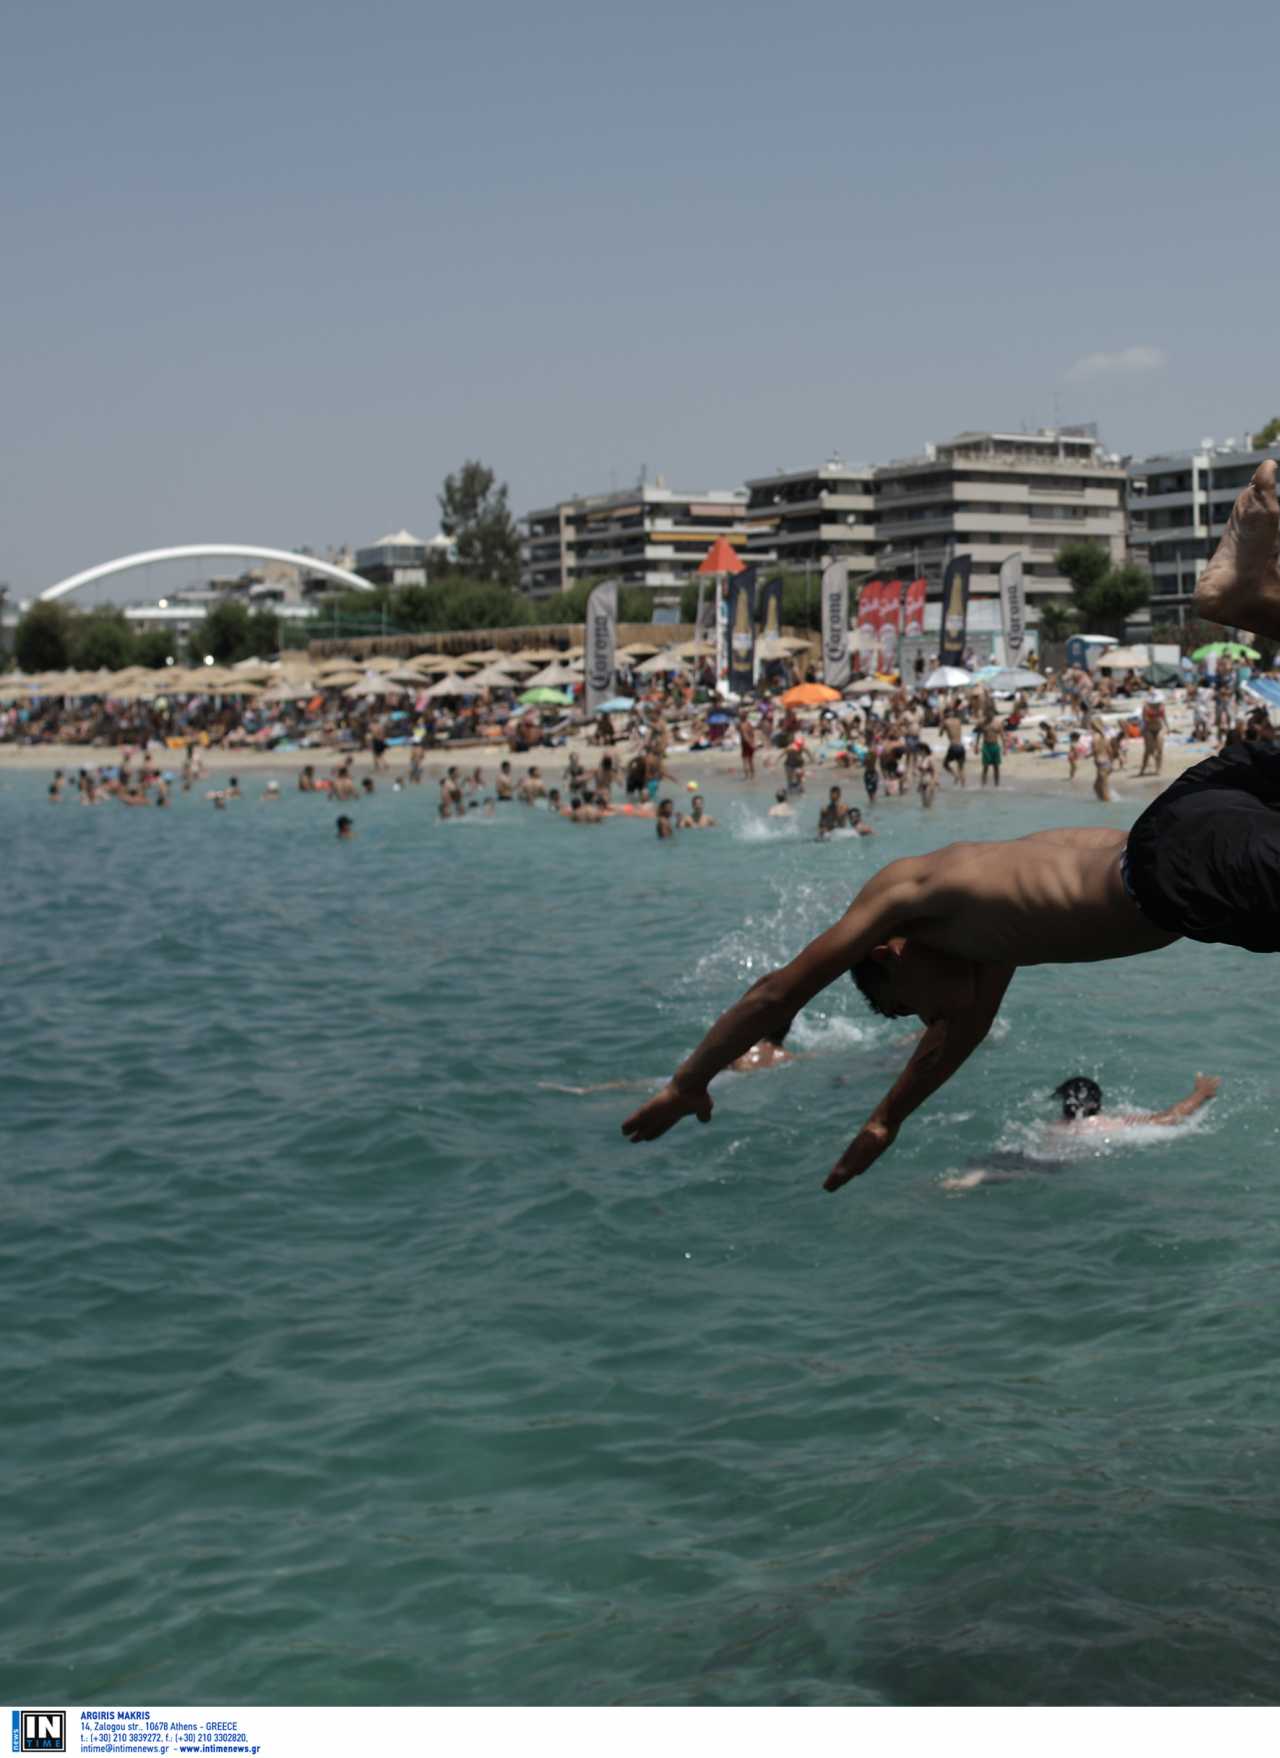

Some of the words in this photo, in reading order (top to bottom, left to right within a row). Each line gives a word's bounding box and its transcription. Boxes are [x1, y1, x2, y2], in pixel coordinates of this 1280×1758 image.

[826, 593, 846, 662] Corona
[1006, 585, 1024, 650] Corona
[591, 615, 611, 690] Corona
